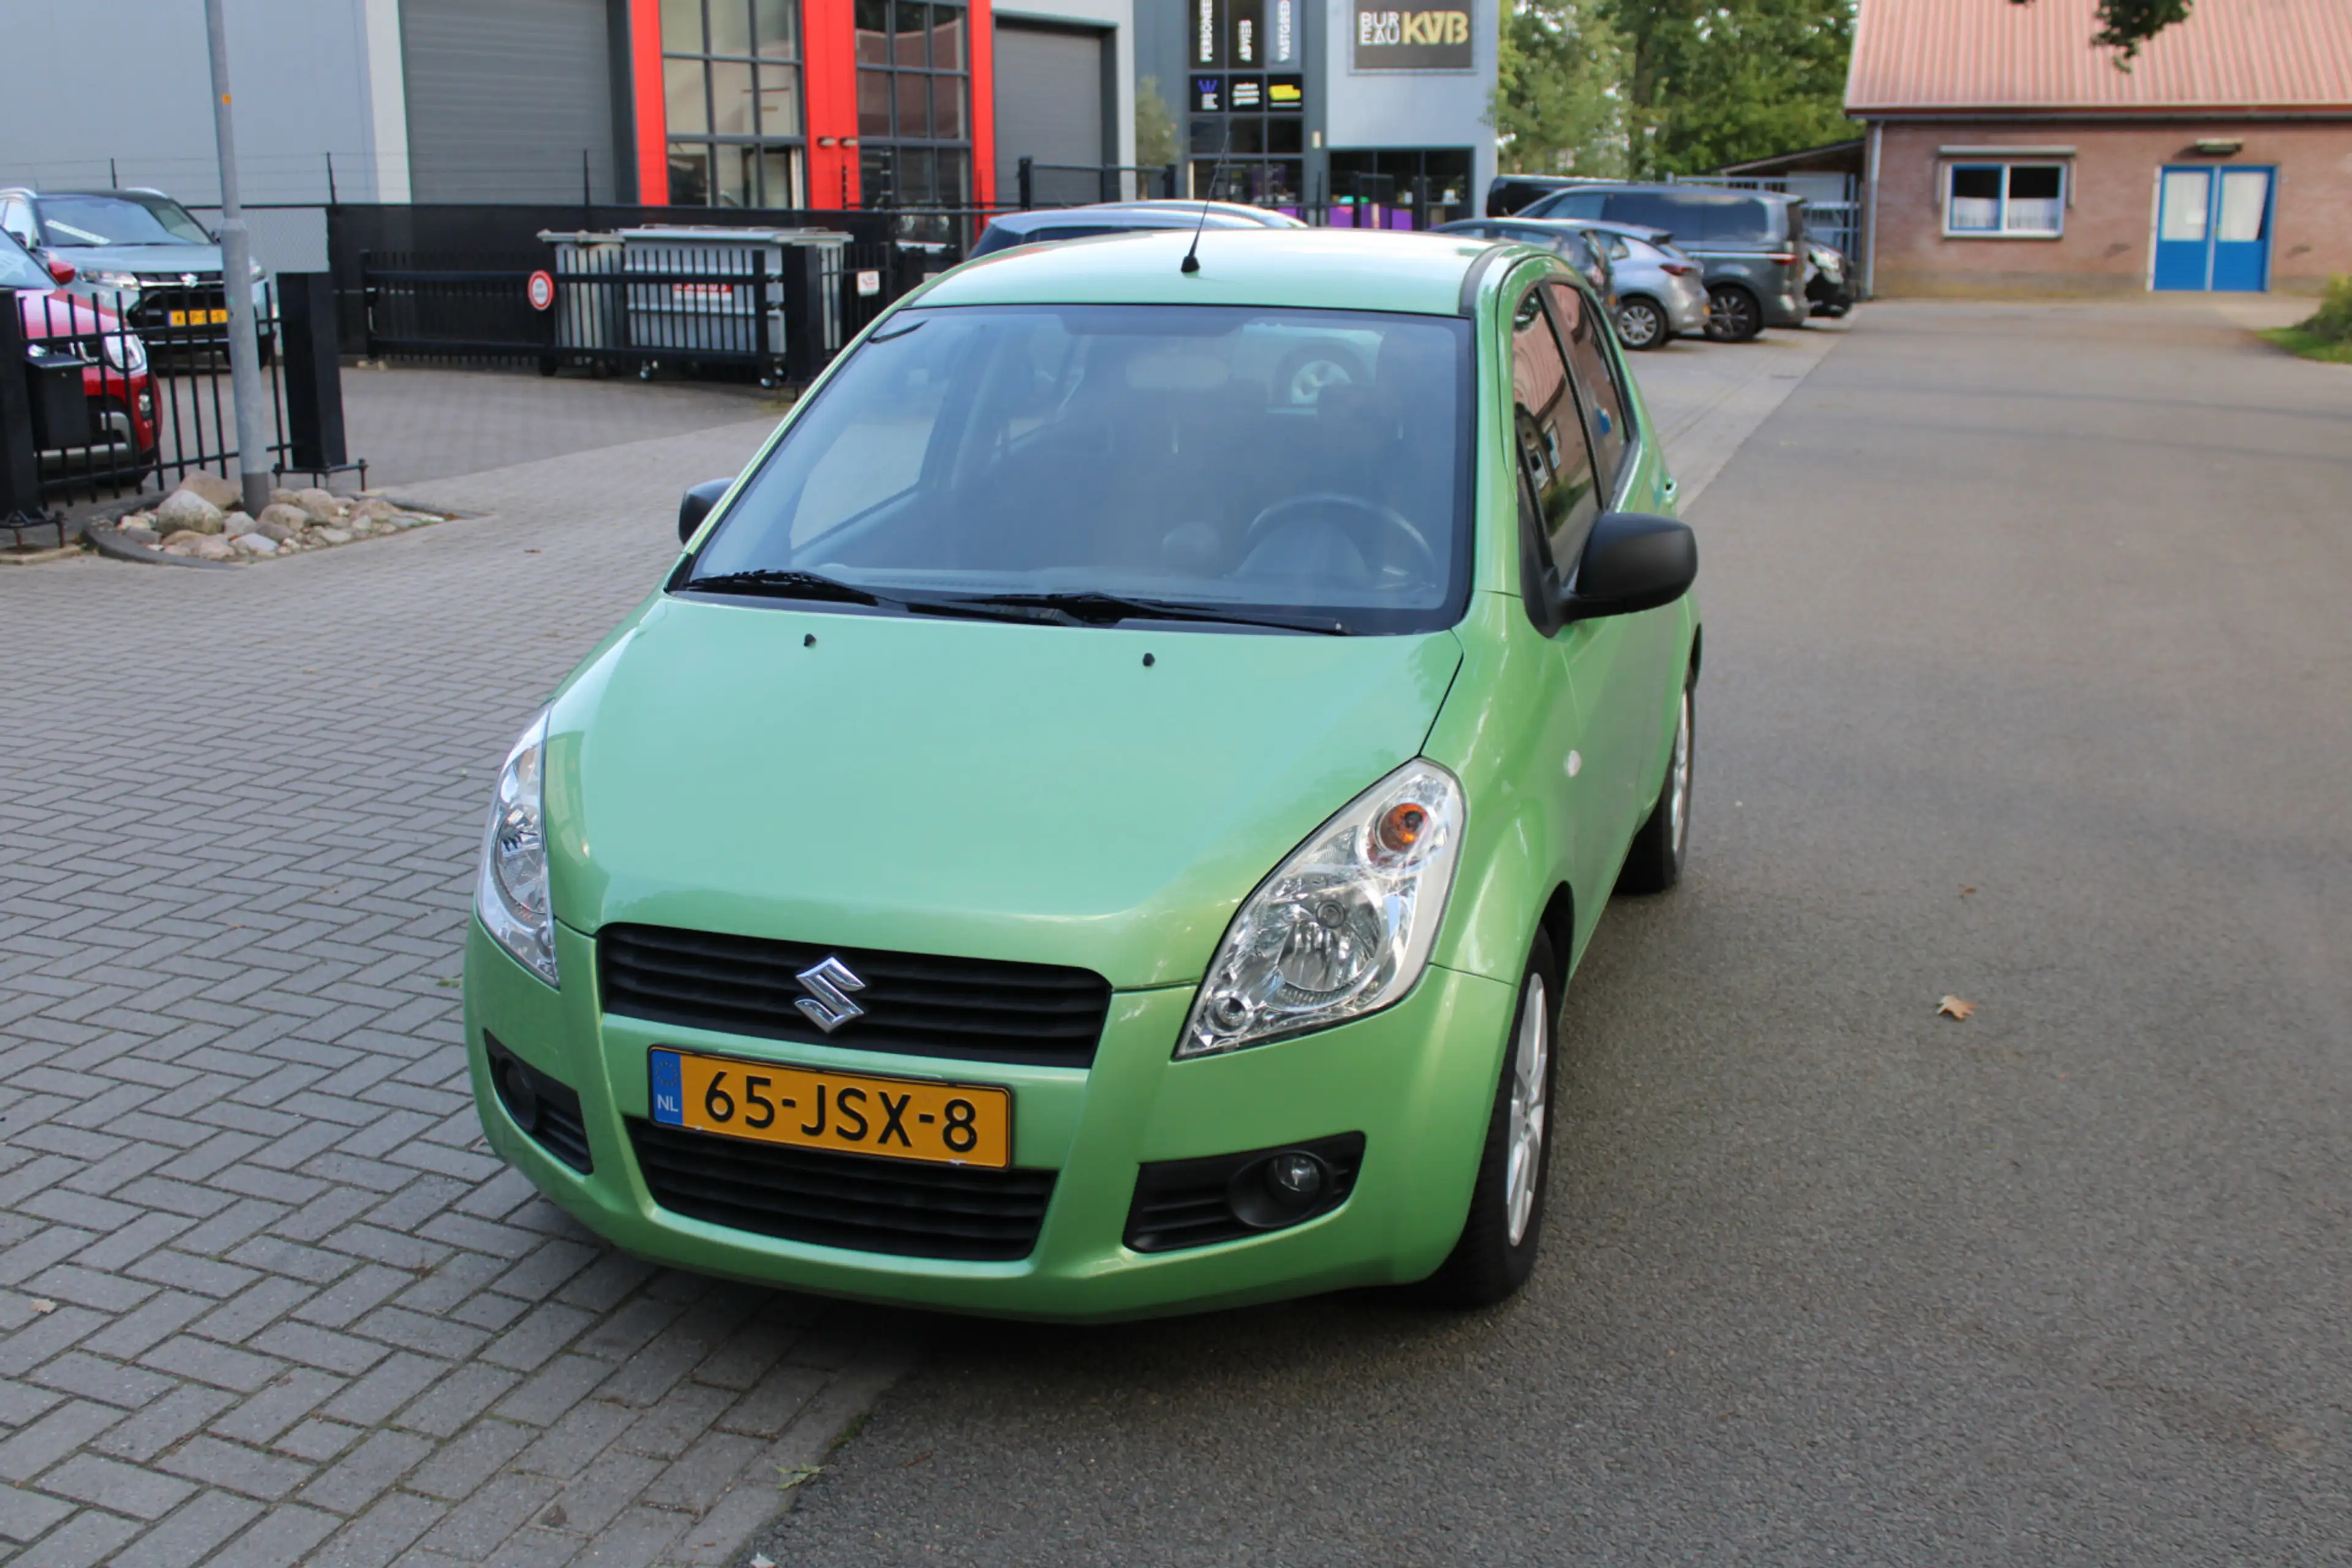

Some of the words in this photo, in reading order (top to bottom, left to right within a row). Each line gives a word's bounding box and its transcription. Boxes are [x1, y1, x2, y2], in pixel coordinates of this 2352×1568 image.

[1359, 11, 1400, 27] BUR
[1402, 11, 1468, 45] KVB
[1238, 20, 1252, 62] ADVIES
[1359, 28, 1400, 45] EAU
[657, 1094, 679, 1112] NL
[705, 1071, 978, 1153] 65-JSX-8
